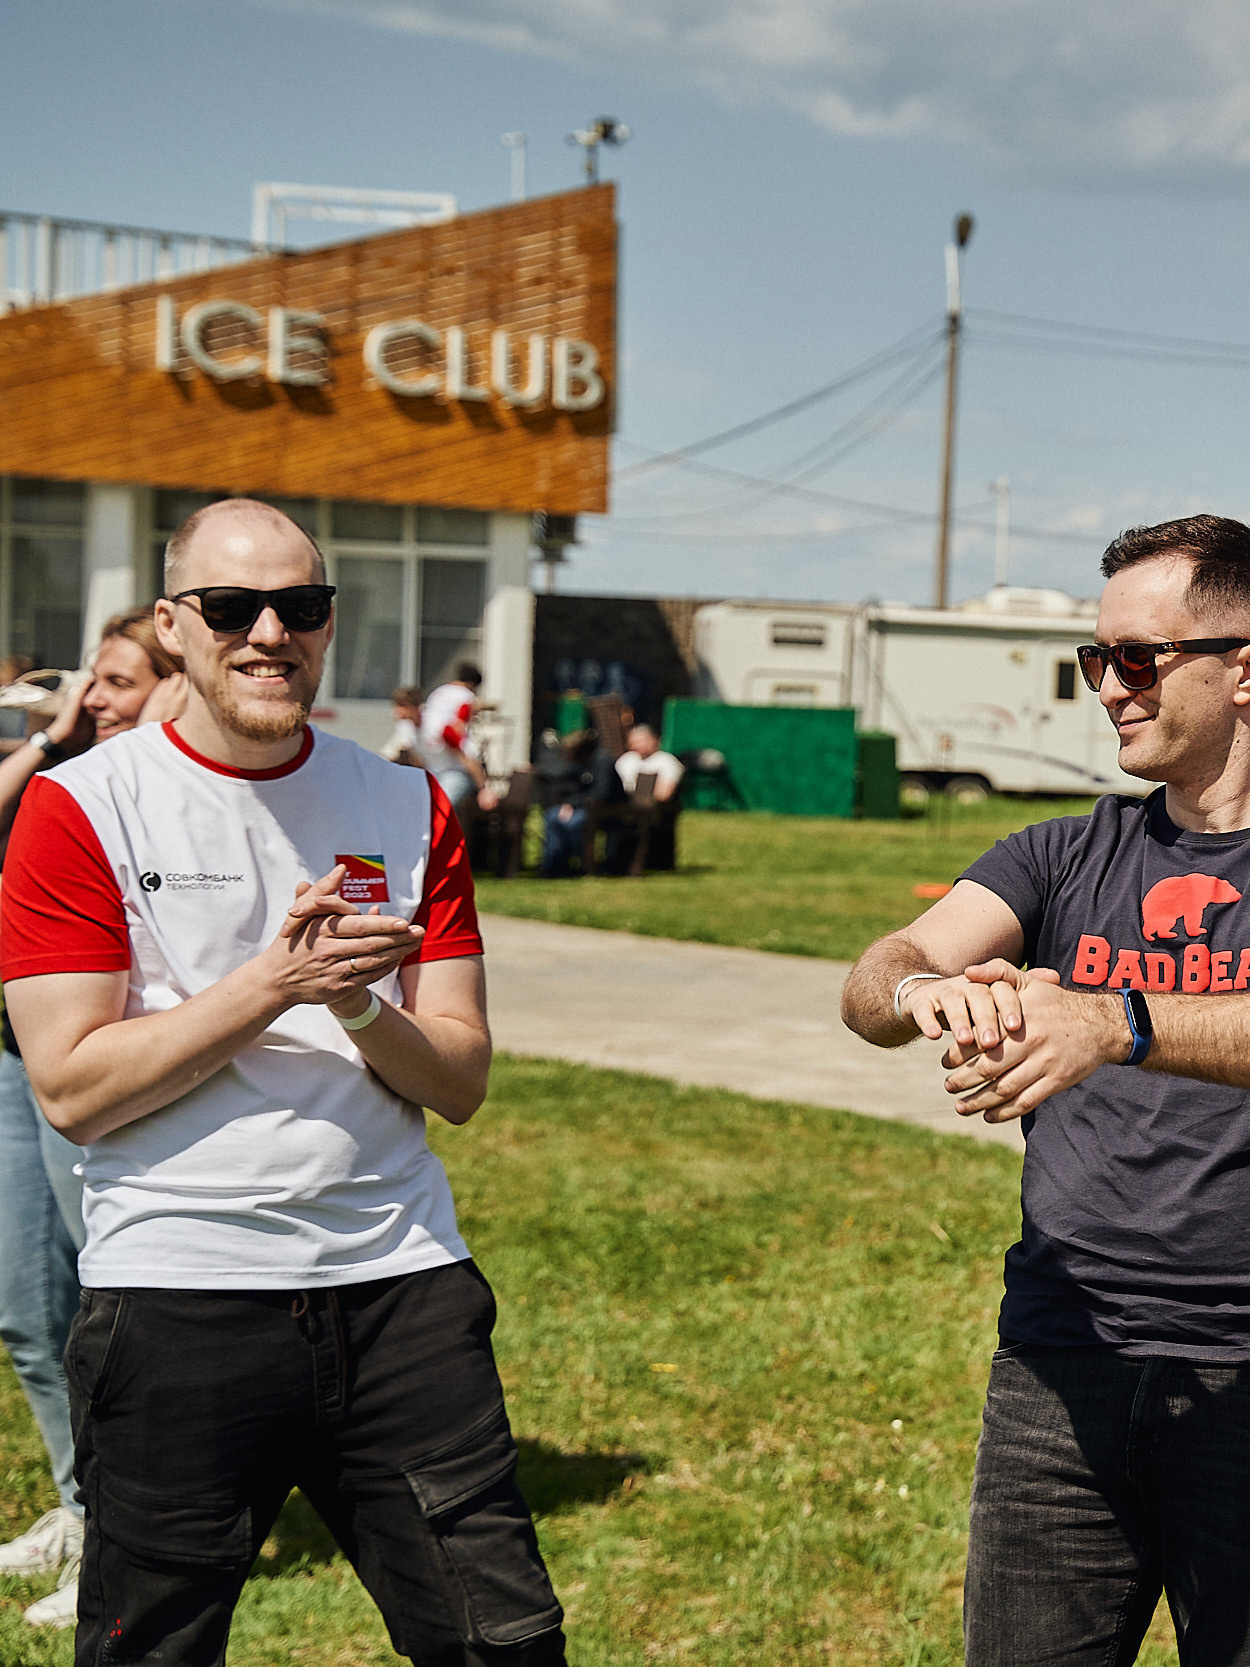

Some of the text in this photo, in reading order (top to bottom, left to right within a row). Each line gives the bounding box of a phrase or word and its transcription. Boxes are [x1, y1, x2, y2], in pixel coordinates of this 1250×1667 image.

[155, 294, 606, 411] ICE CLUB
[165, 873, 245, 883] СОВКОМБАНК
